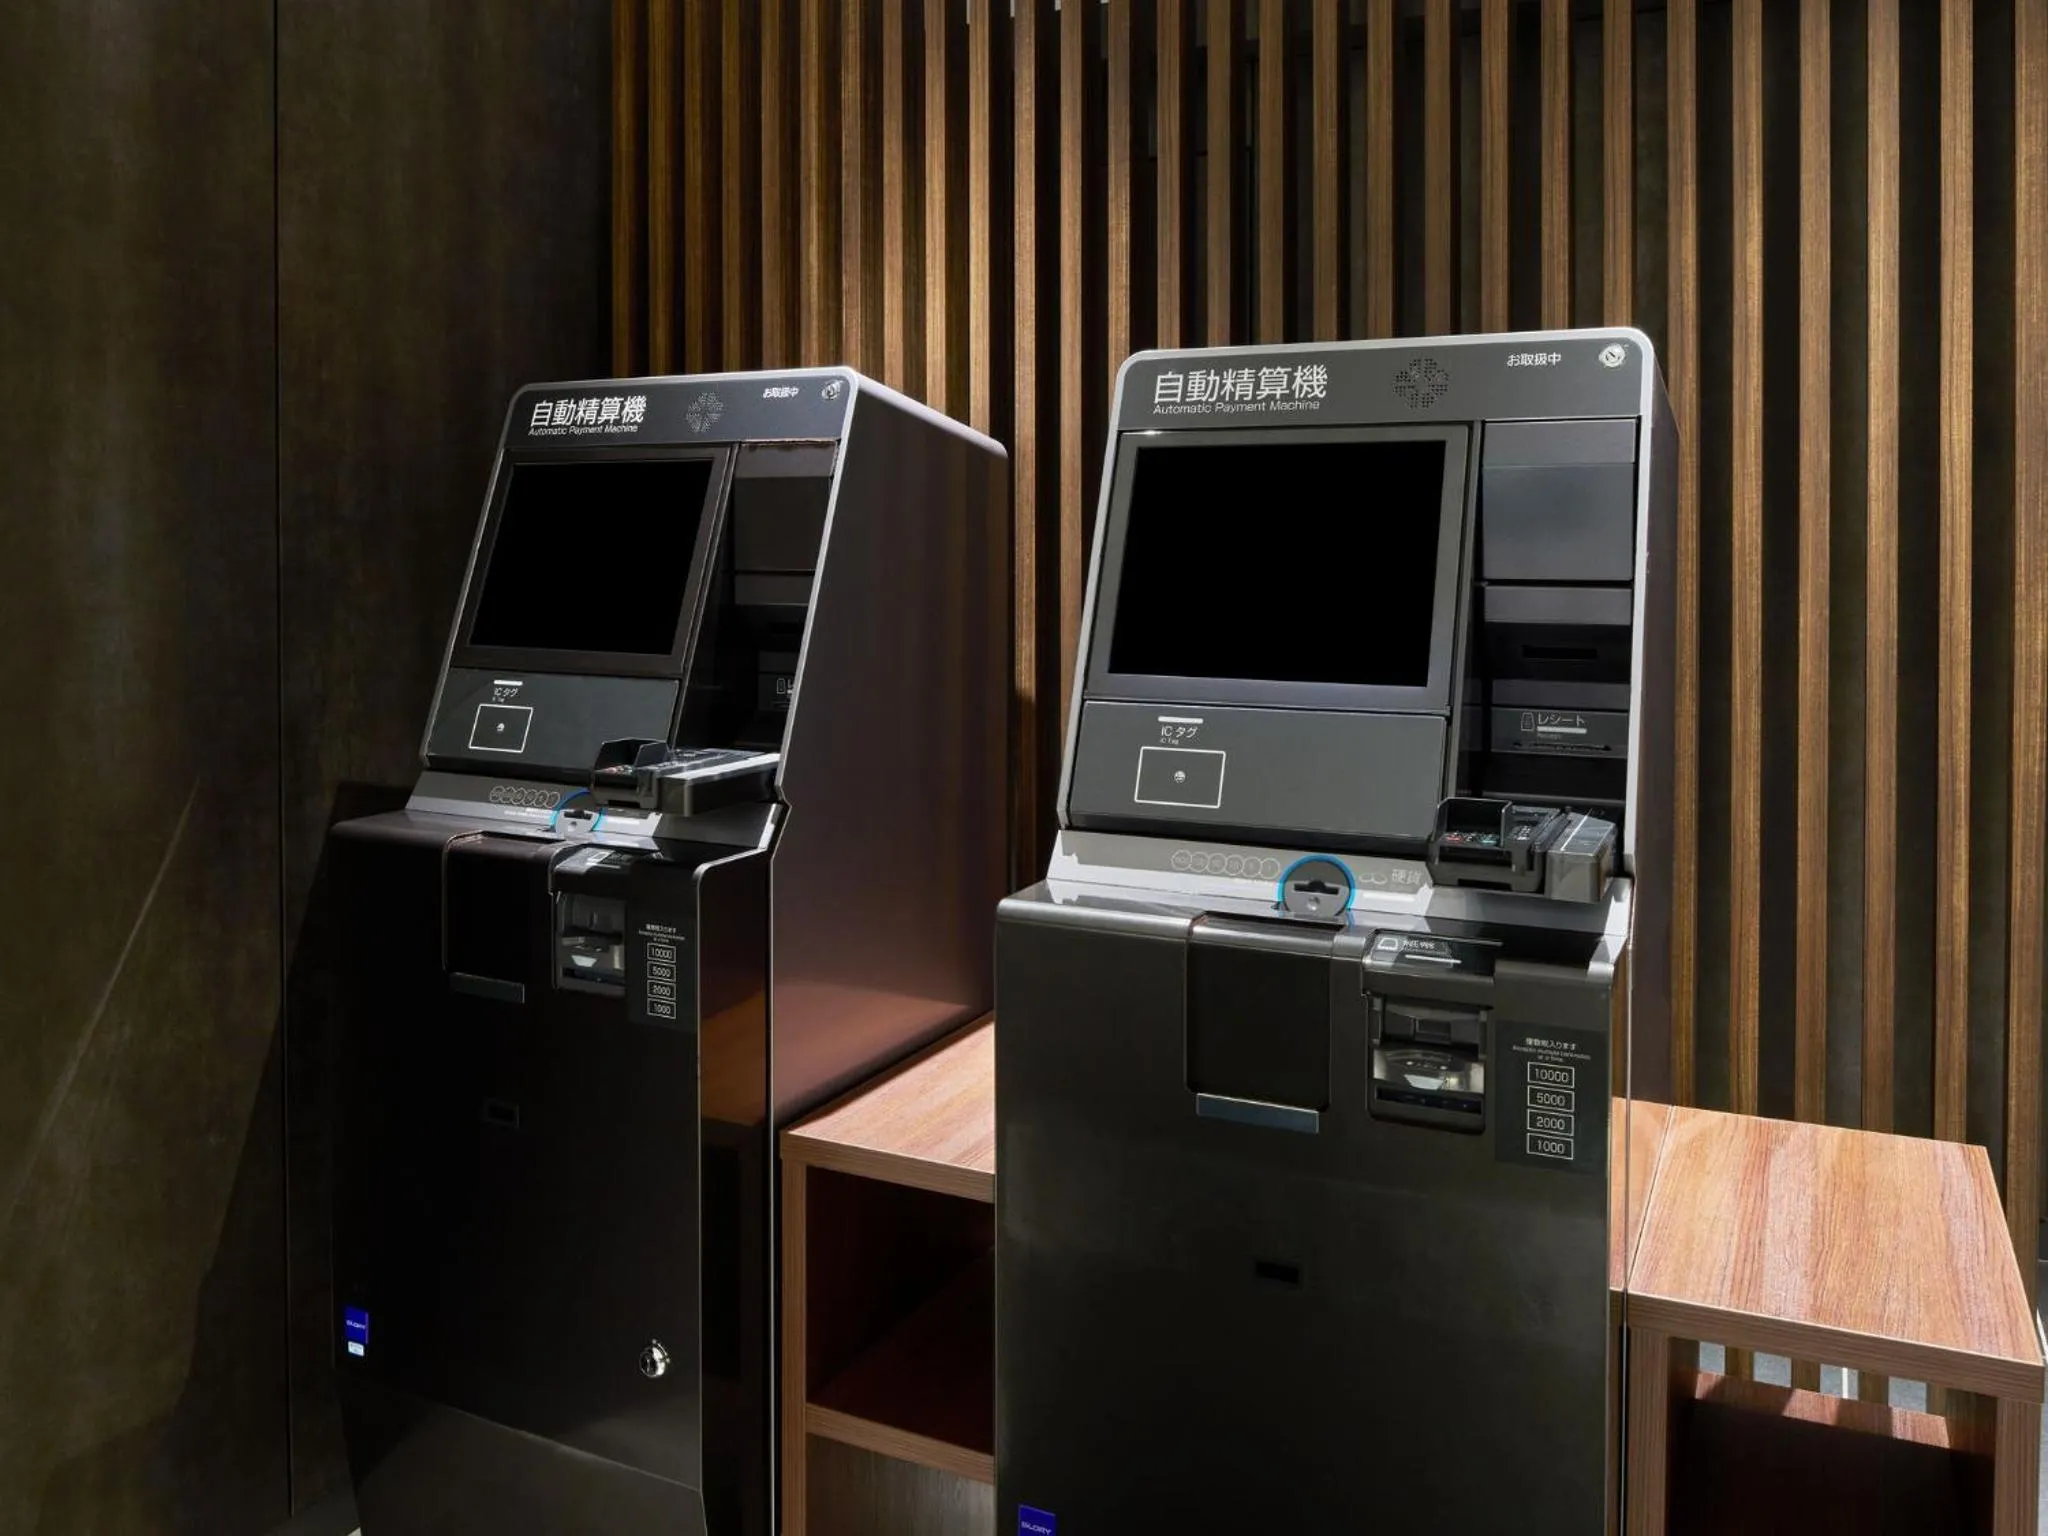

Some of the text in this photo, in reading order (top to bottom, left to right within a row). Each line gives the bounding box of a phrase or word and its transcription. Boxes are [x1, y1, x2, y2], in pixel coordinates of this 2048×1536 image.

[1154, 364, 1328, 404] 自動精算機
[530, 395, 647, 427] 自動精算機
[1153, 400, 1320, 415] Automatic Payment Machine
[528, 424, 639, 436] Automatic Payment Machine
[1538, 712, 1585, 727] レシート
[651, 947, 673, 960] 10000
[653, 965, 671, 978] 5000
[653, 984, 671, 997] 2000
[653, 1003, 671, 1015] 1000
[1535, 1068, 1569, 1083] 10000
[1536, 1092, 1566, 1107] 5000
[1536, 1116, 1566, 1131] 2000
[1537, 1140, 1565, 1155] 1000
